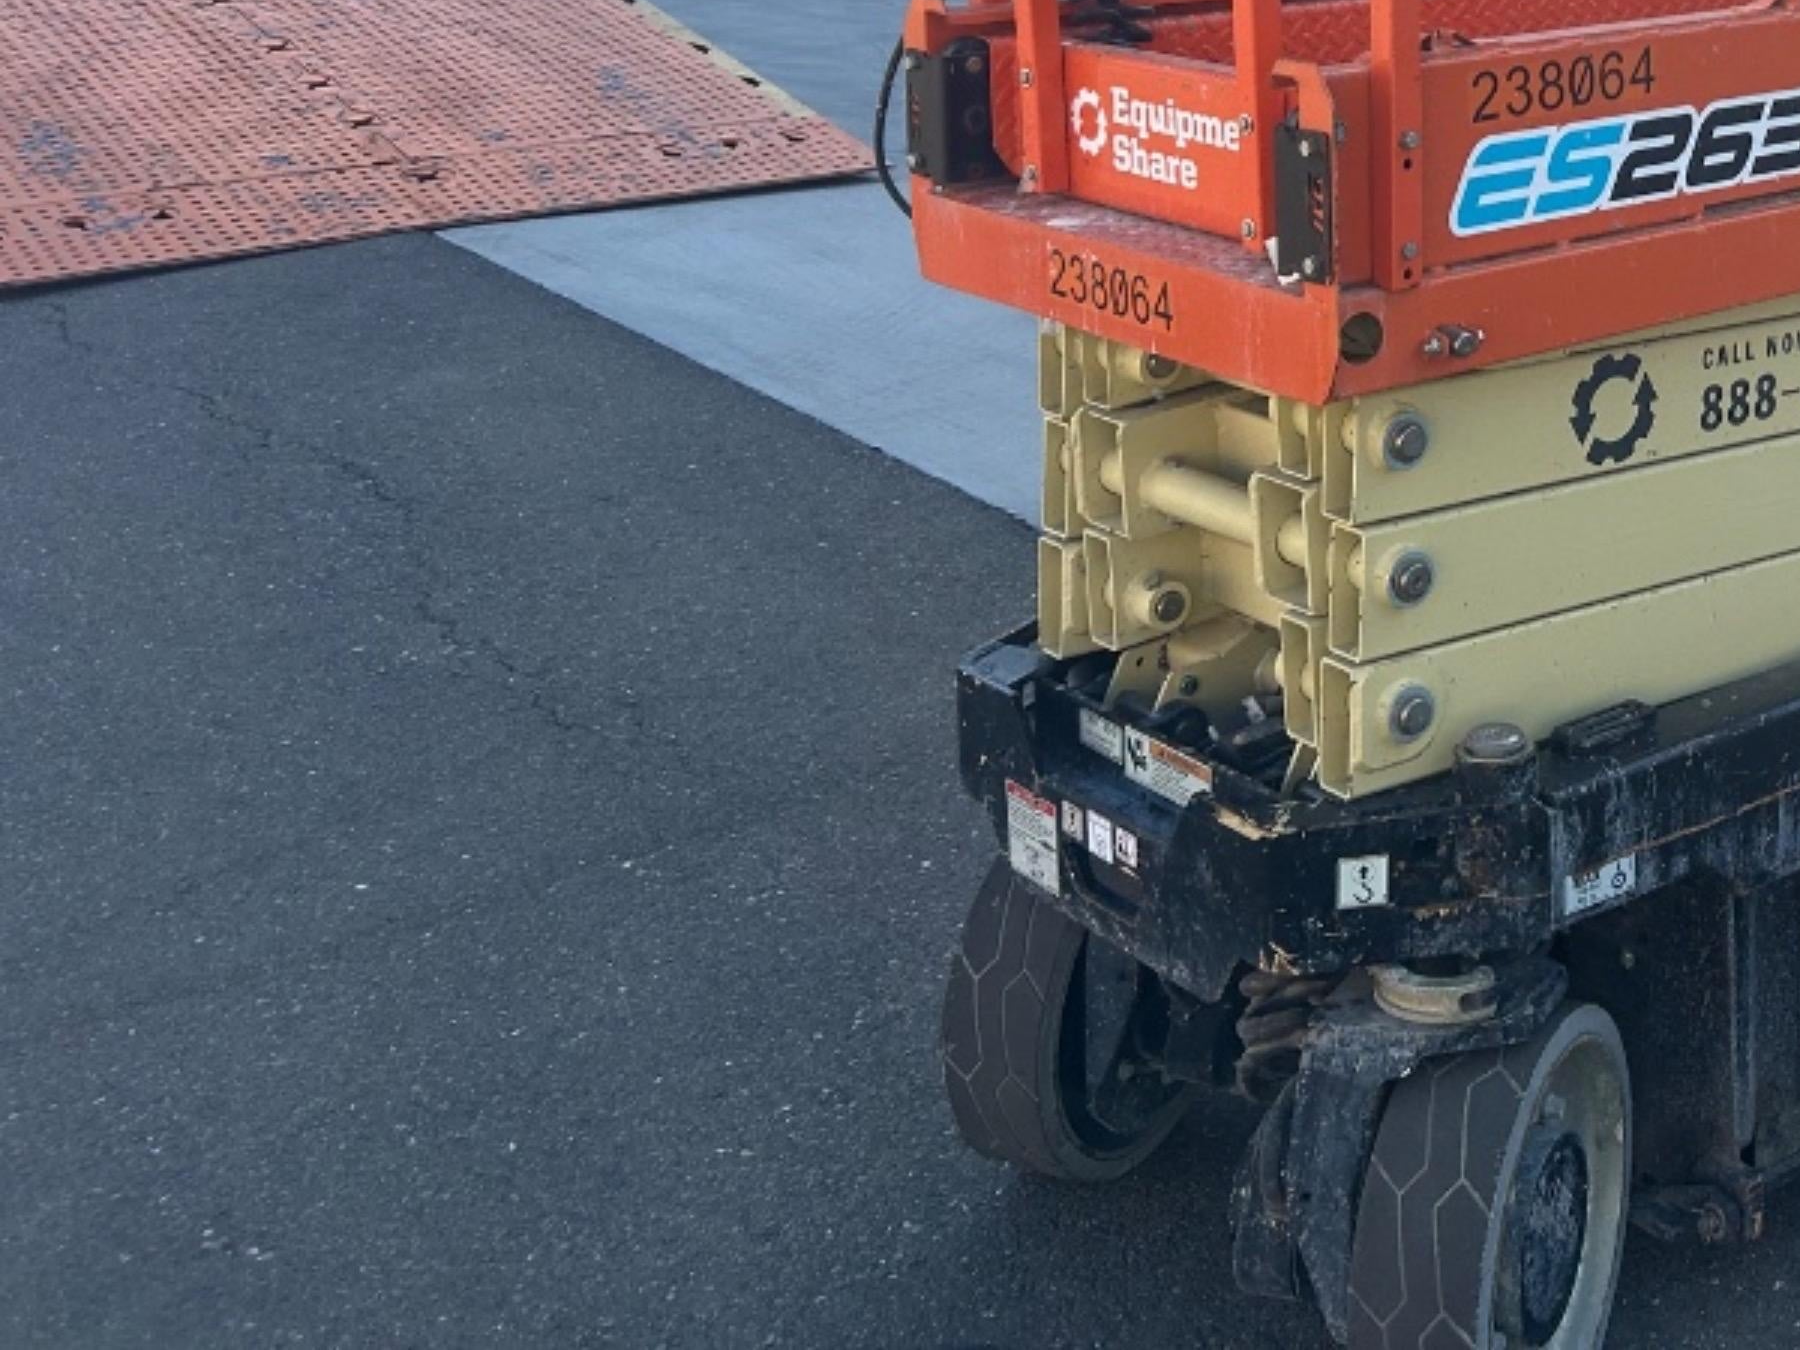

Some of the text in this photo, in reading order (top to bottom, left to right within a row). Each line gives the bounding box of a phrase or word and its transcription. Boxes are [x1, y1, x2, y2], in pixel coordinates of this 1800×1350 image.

[1471, 46, 1656, 124] 238064
[1110, 86, 1241, 151] Equipme
[1112, 134, 1198, 190] Share
[1049, 250, 1174, 331] 238064
[1703, 340, 1755, 369] CALL
